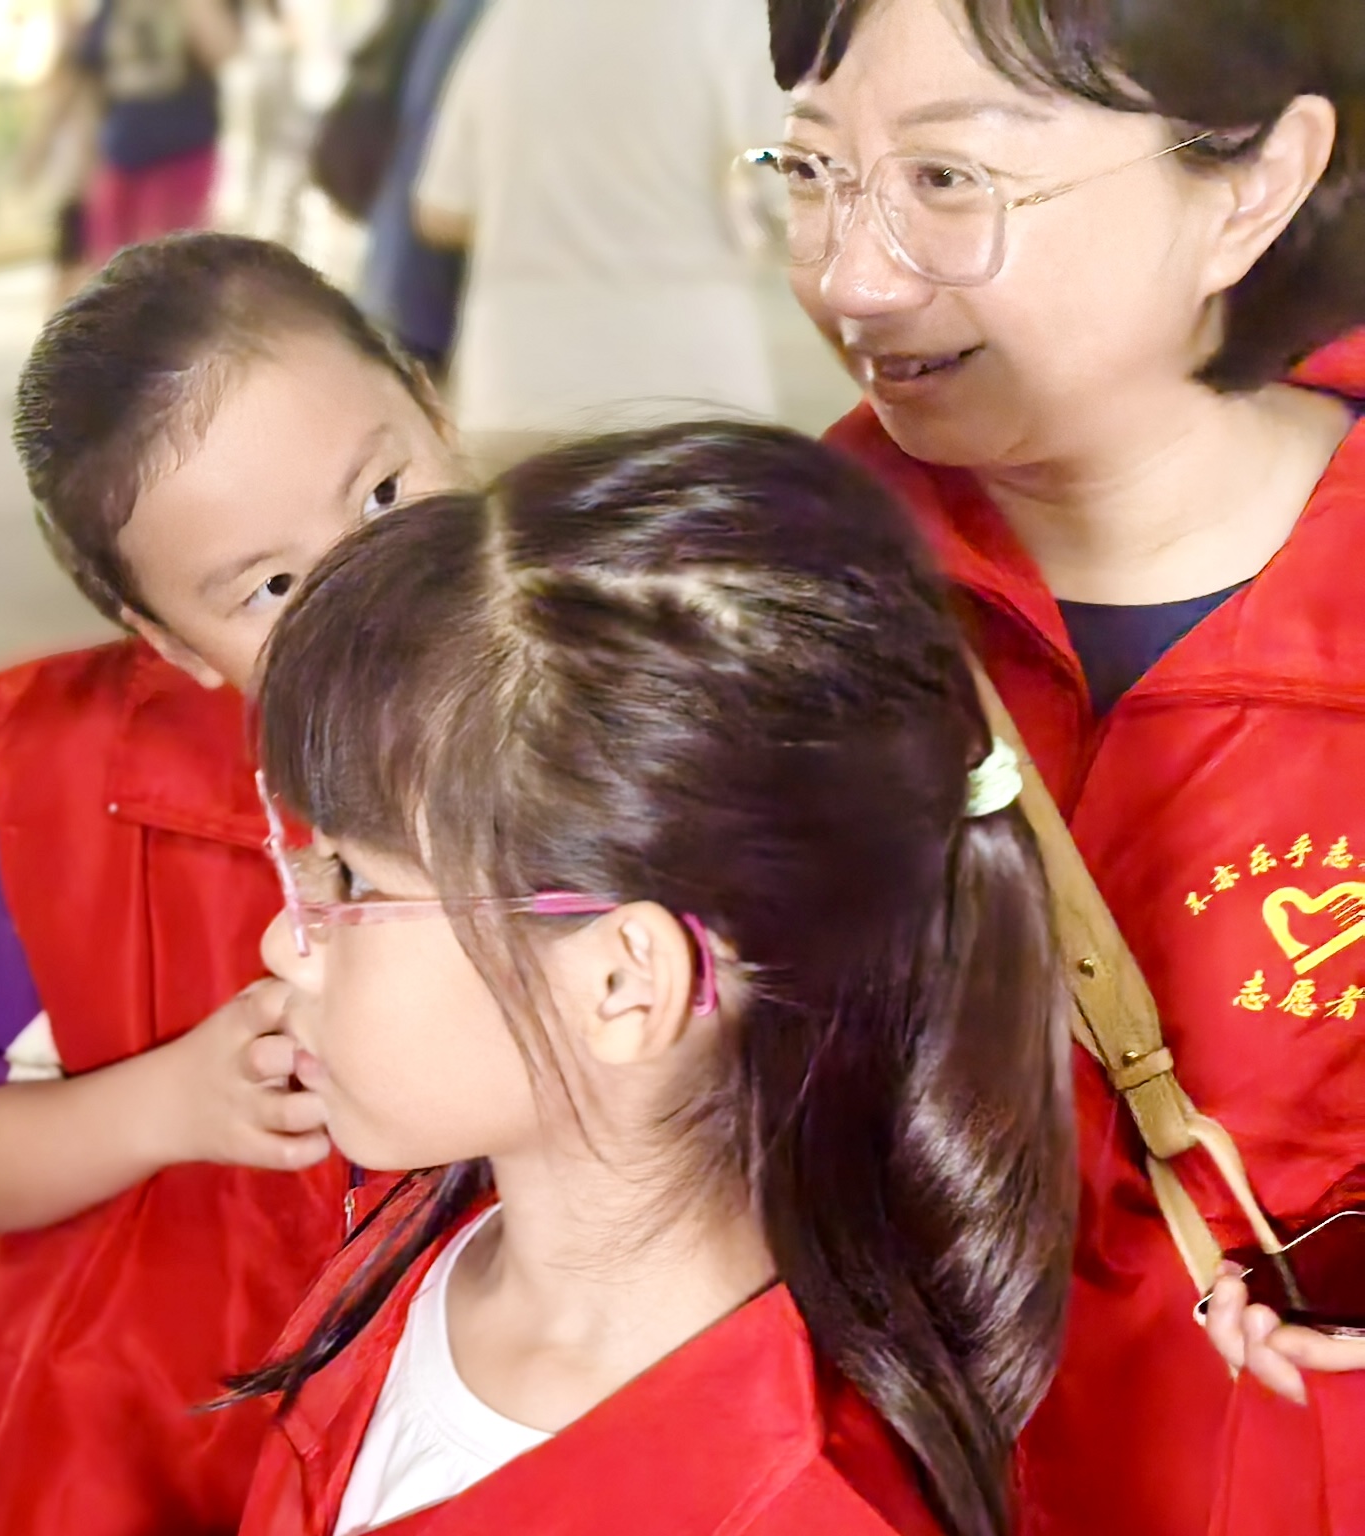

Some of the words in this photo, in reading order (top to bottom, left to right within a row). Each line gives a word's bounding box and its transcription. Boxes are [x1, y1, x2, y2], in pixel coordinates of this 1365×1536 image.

[1184, 833, 1365, 916] 不亦乐乎志
[1232, 969, 1365, 1020] 志愿者
